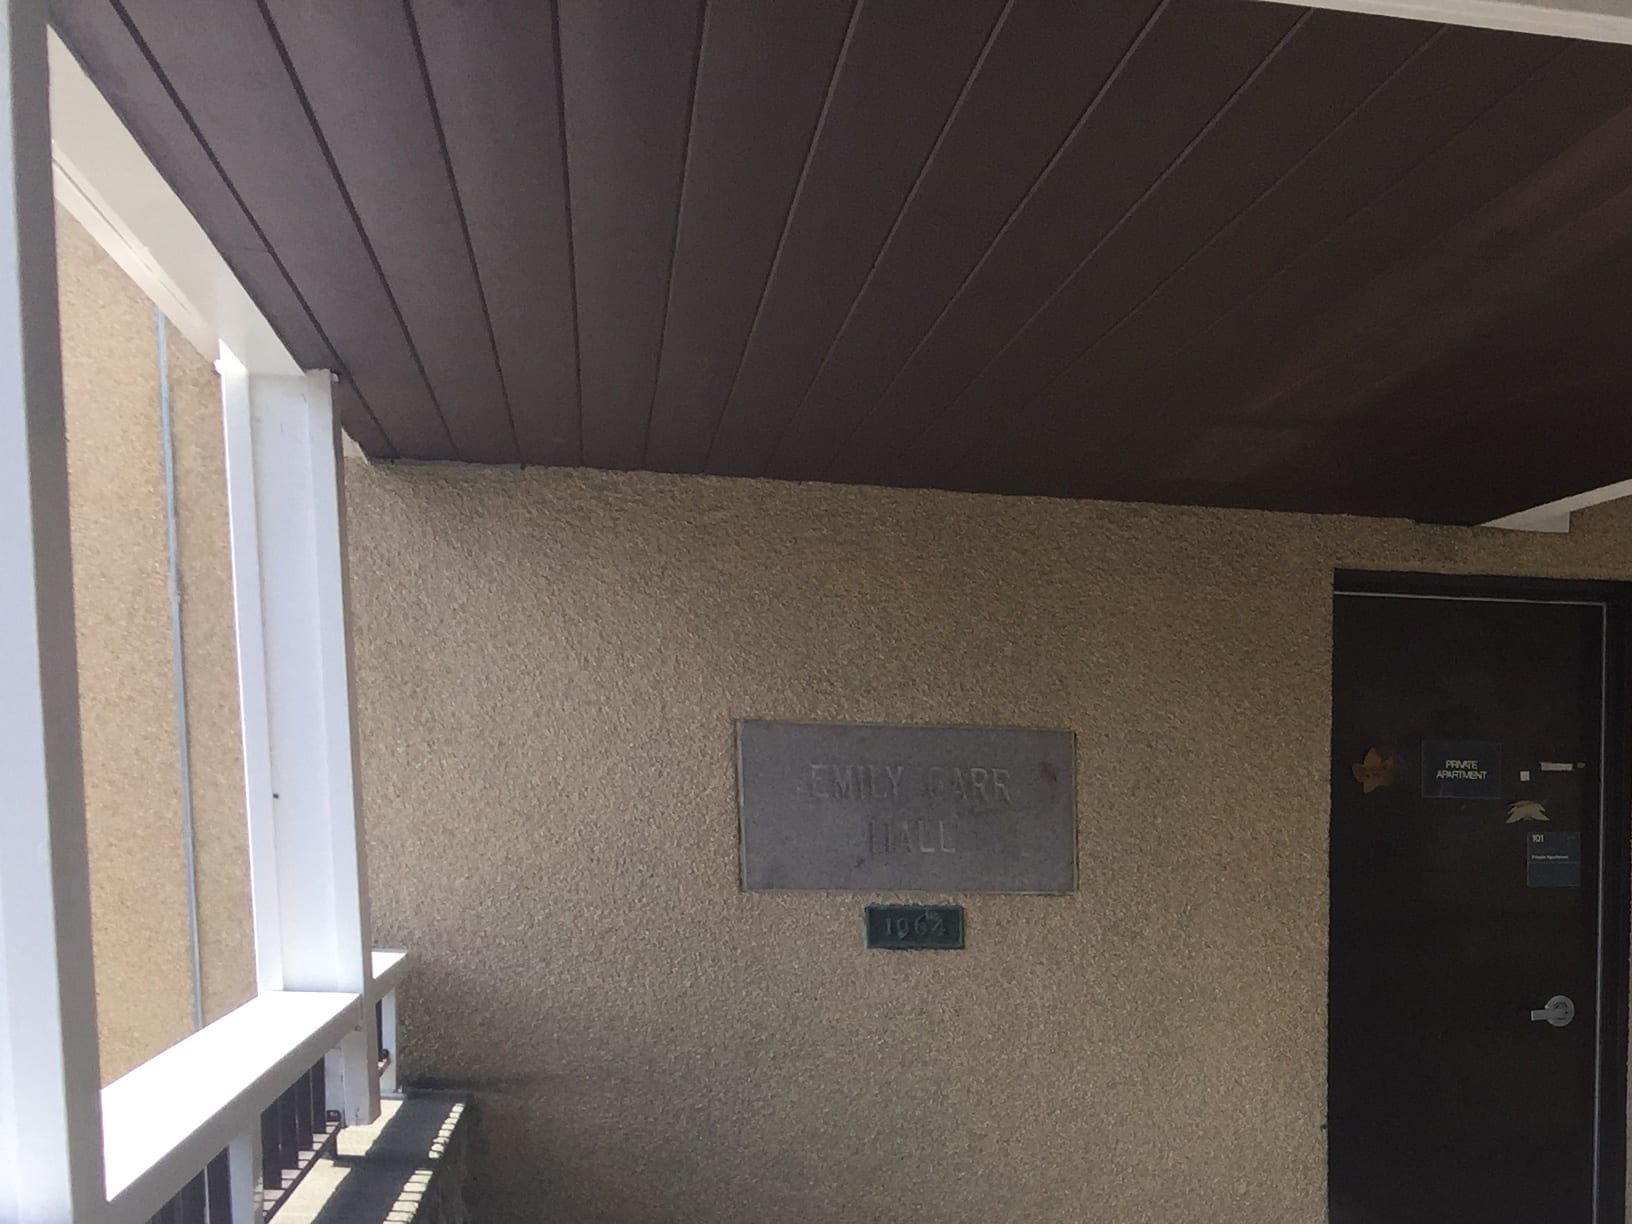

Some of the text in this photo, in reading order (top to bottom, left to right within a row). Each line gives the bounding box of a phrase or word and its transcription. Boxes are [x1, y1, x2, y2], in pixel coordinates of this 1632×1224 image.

[1436, 769, 1488, 781] APARTMENT
[1445, 759, 1478, 770] PRIVATE
[809, 763, 1013, 803] EMILY CARR
[868, 820, 957, 856] HALL
[886, 915, 947, 939] 1964
